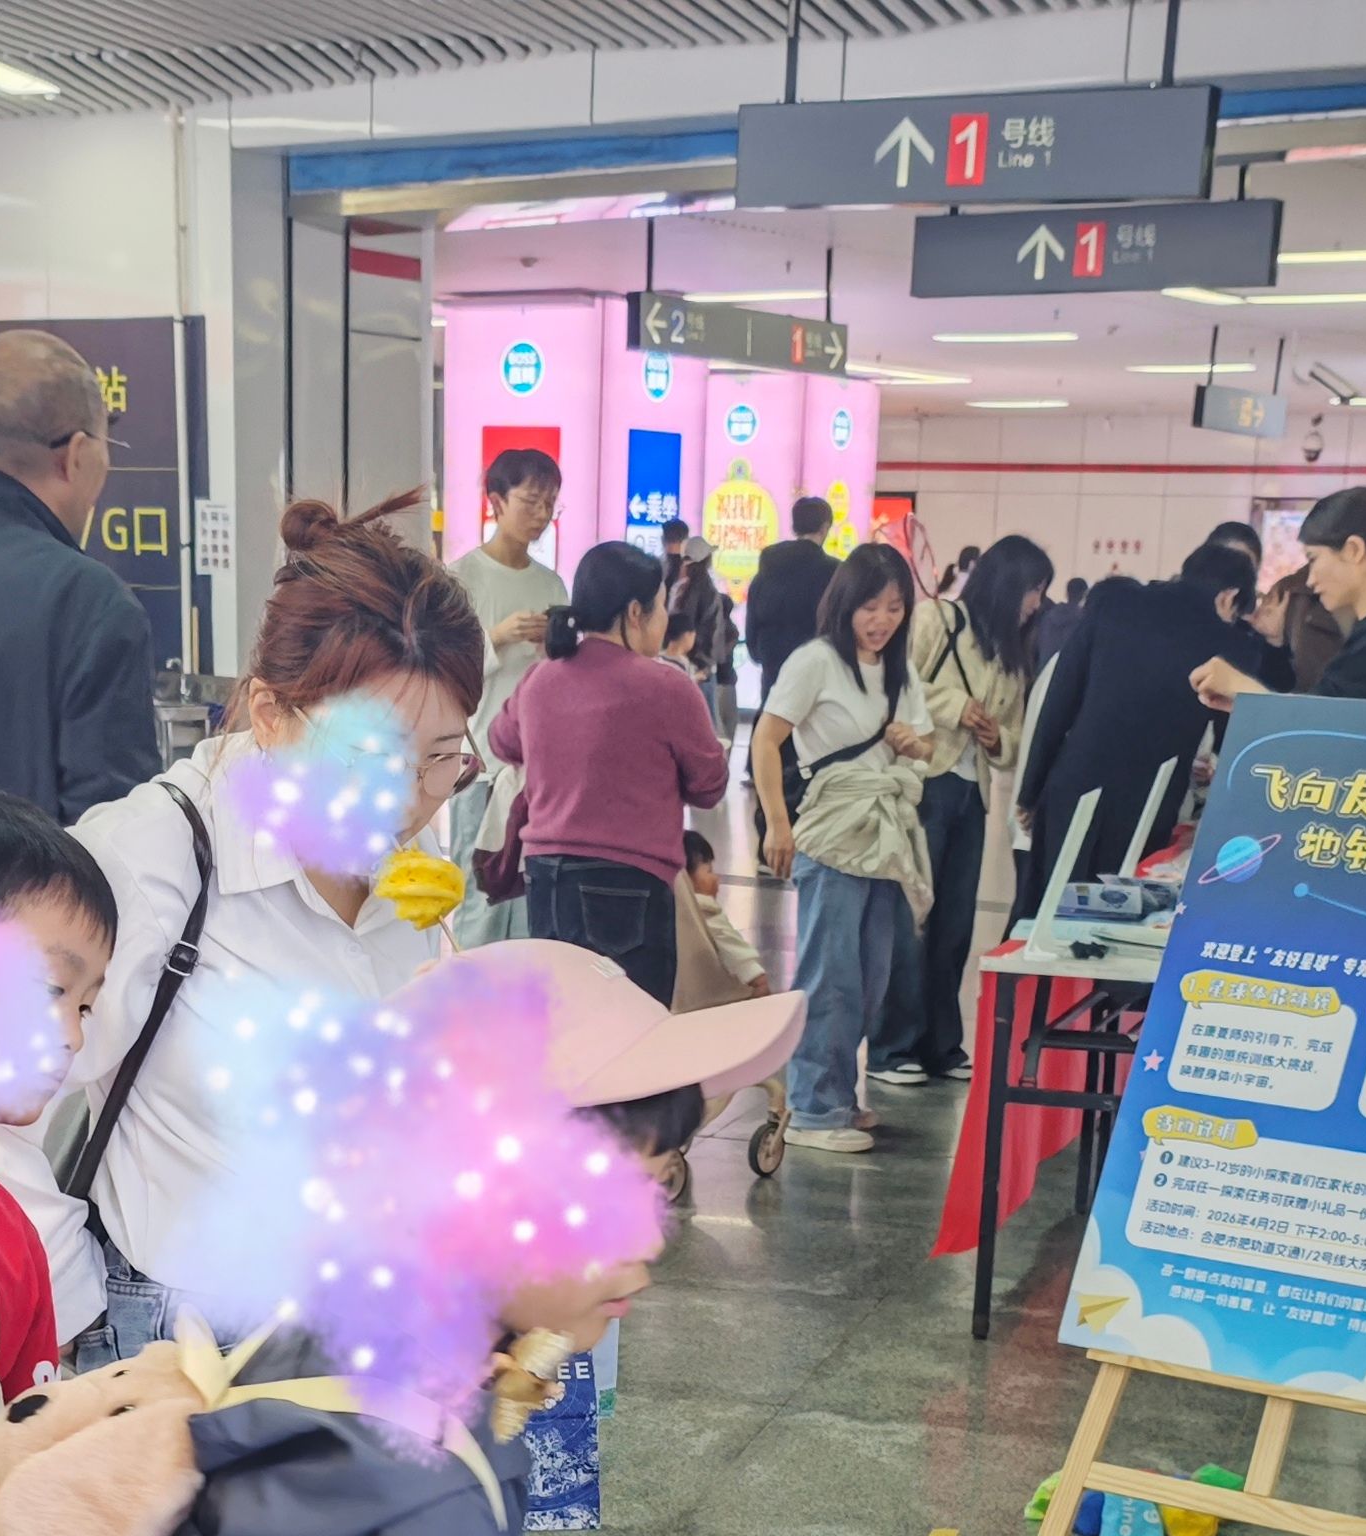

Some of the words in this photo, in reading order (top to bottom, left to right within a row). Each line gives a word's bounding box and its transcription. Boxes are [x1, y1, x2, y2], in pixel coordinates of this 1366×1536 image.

[954, 119, 979, 180] 1
[1001, 115, 1055, 148] 号线
[997, 151, 1034, 169] Line
[1044, 150, 1053, 168] 1
[1079, 225, 1099, 274] 1
[1116, 223, 1157, 248] 号线
[670, 309, 685, 344] 2
[791, 326, 805, 365] 1
